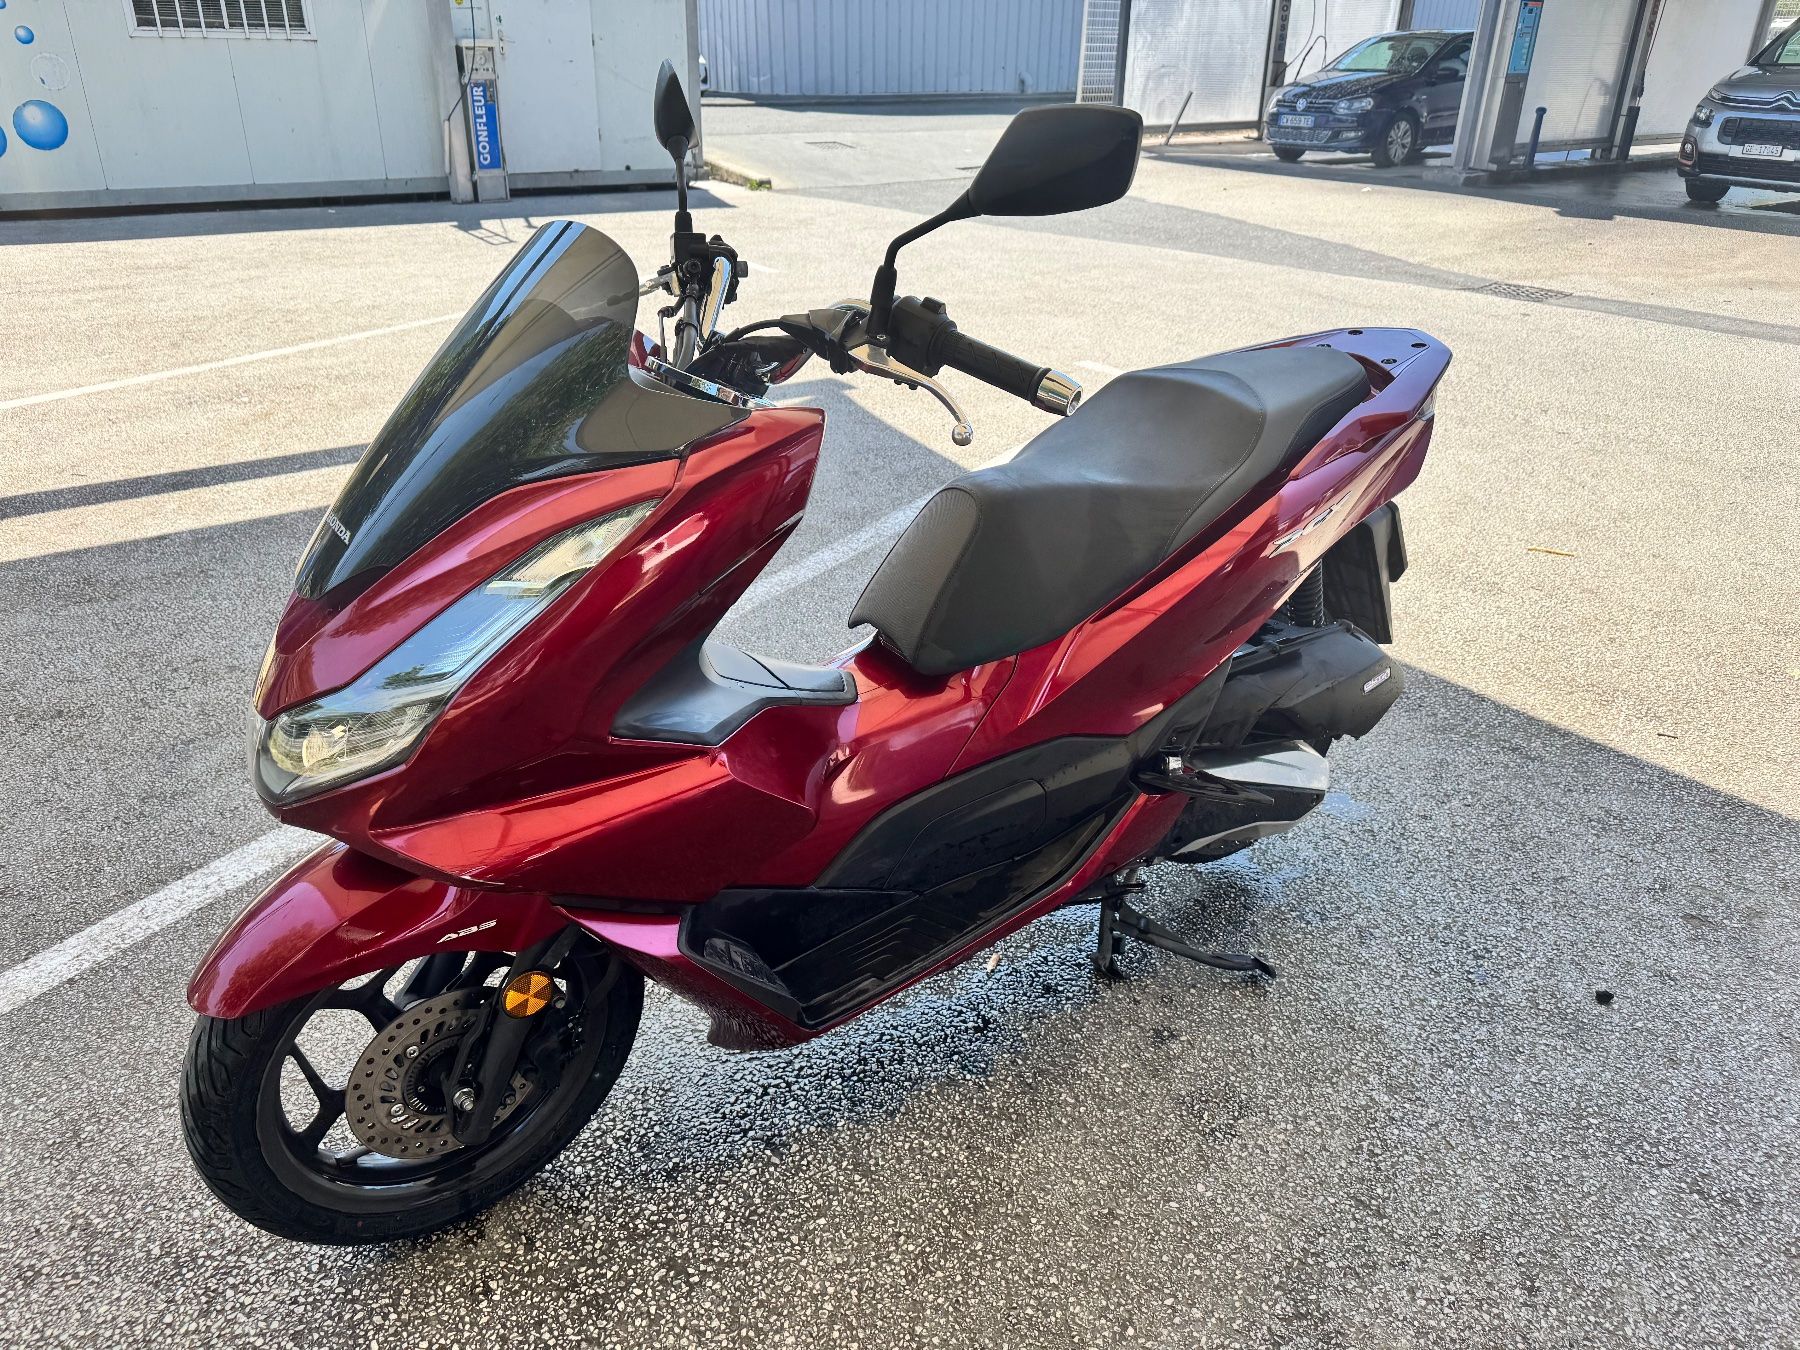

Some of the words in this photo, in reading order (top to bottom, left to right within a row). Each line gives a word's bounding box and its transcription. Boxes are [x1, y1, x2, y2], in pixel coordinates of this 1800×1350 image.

[1277, 0, 1290, 51] OUSSE
[472, 86, 491, 165] GONFLEUR
[436, 918, 498, 944] ABS
